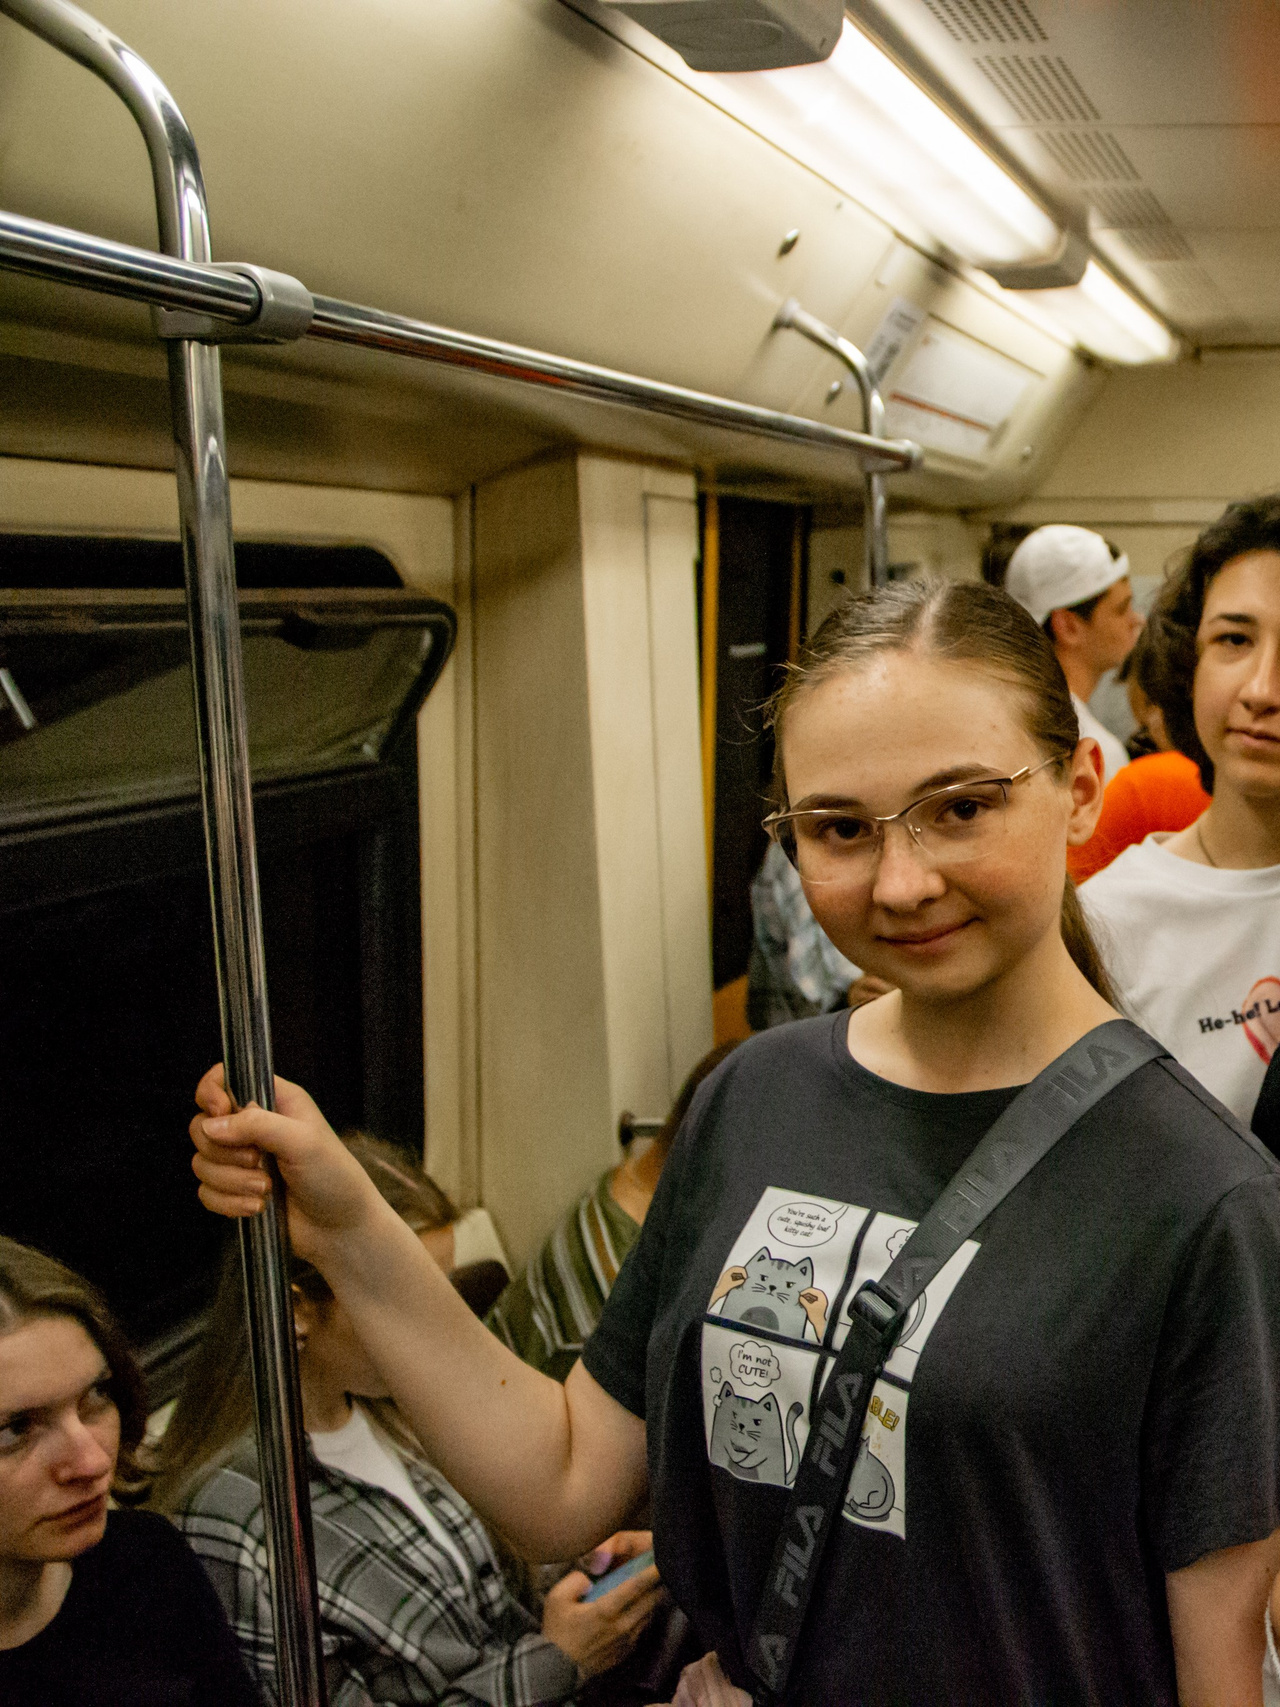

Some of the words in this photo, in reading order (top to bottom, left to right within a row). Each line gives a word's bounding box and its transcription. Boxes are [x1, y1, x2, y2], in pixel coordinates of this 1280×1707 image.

[1198, 1002, 1262, 1034] He-he!
[1033, 1043, 1131, 1120] FILA
[938, 1138, 1028, 1234] FILA
[784, 1225, 799, 1237] kitty
[806, 1213, 820, 1221] such
[737, 1349, 752, 1362] I'm
[755, 1356, 773, 1367] not
[738, 1363, 769, 1379] CUTE!
[810, 1371, 864, 1479] FILA
[868, 1395, 900, 1432] BLE!
[773, 1504, 826, 1609] FILA
